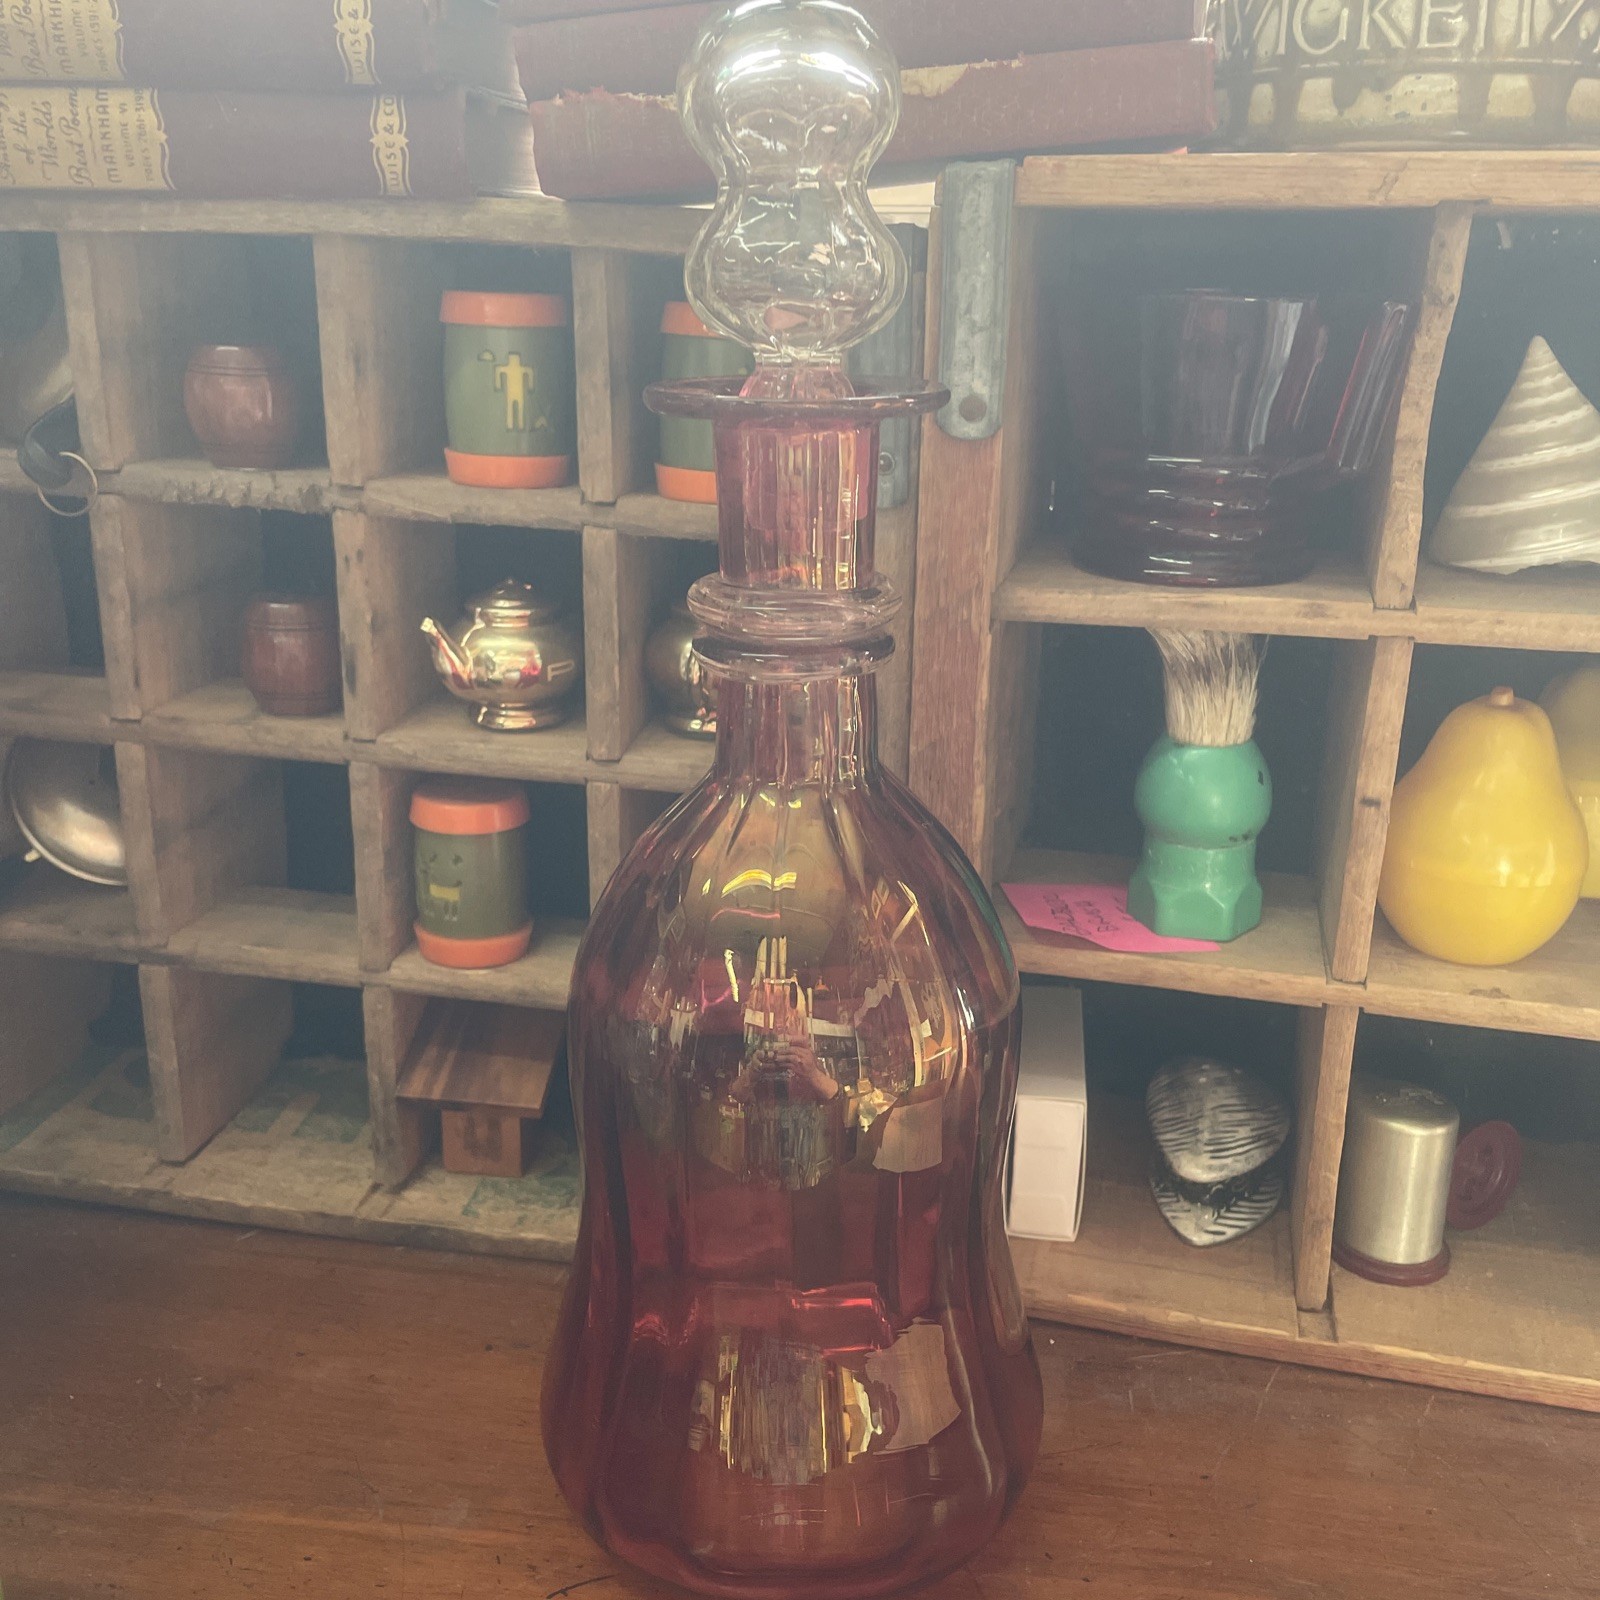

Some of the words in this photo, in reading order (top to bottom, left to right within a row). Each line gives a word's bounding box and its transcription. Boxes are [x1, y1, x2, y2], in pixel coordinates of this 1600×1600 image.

[18, 29, 48, 76] Best
[8, 111, 28, 138] the
[95, 89, 122, 183] MARKHAM
[120, 122, 135, 167] VOLUME
[65, 139, 94, 187] Best
